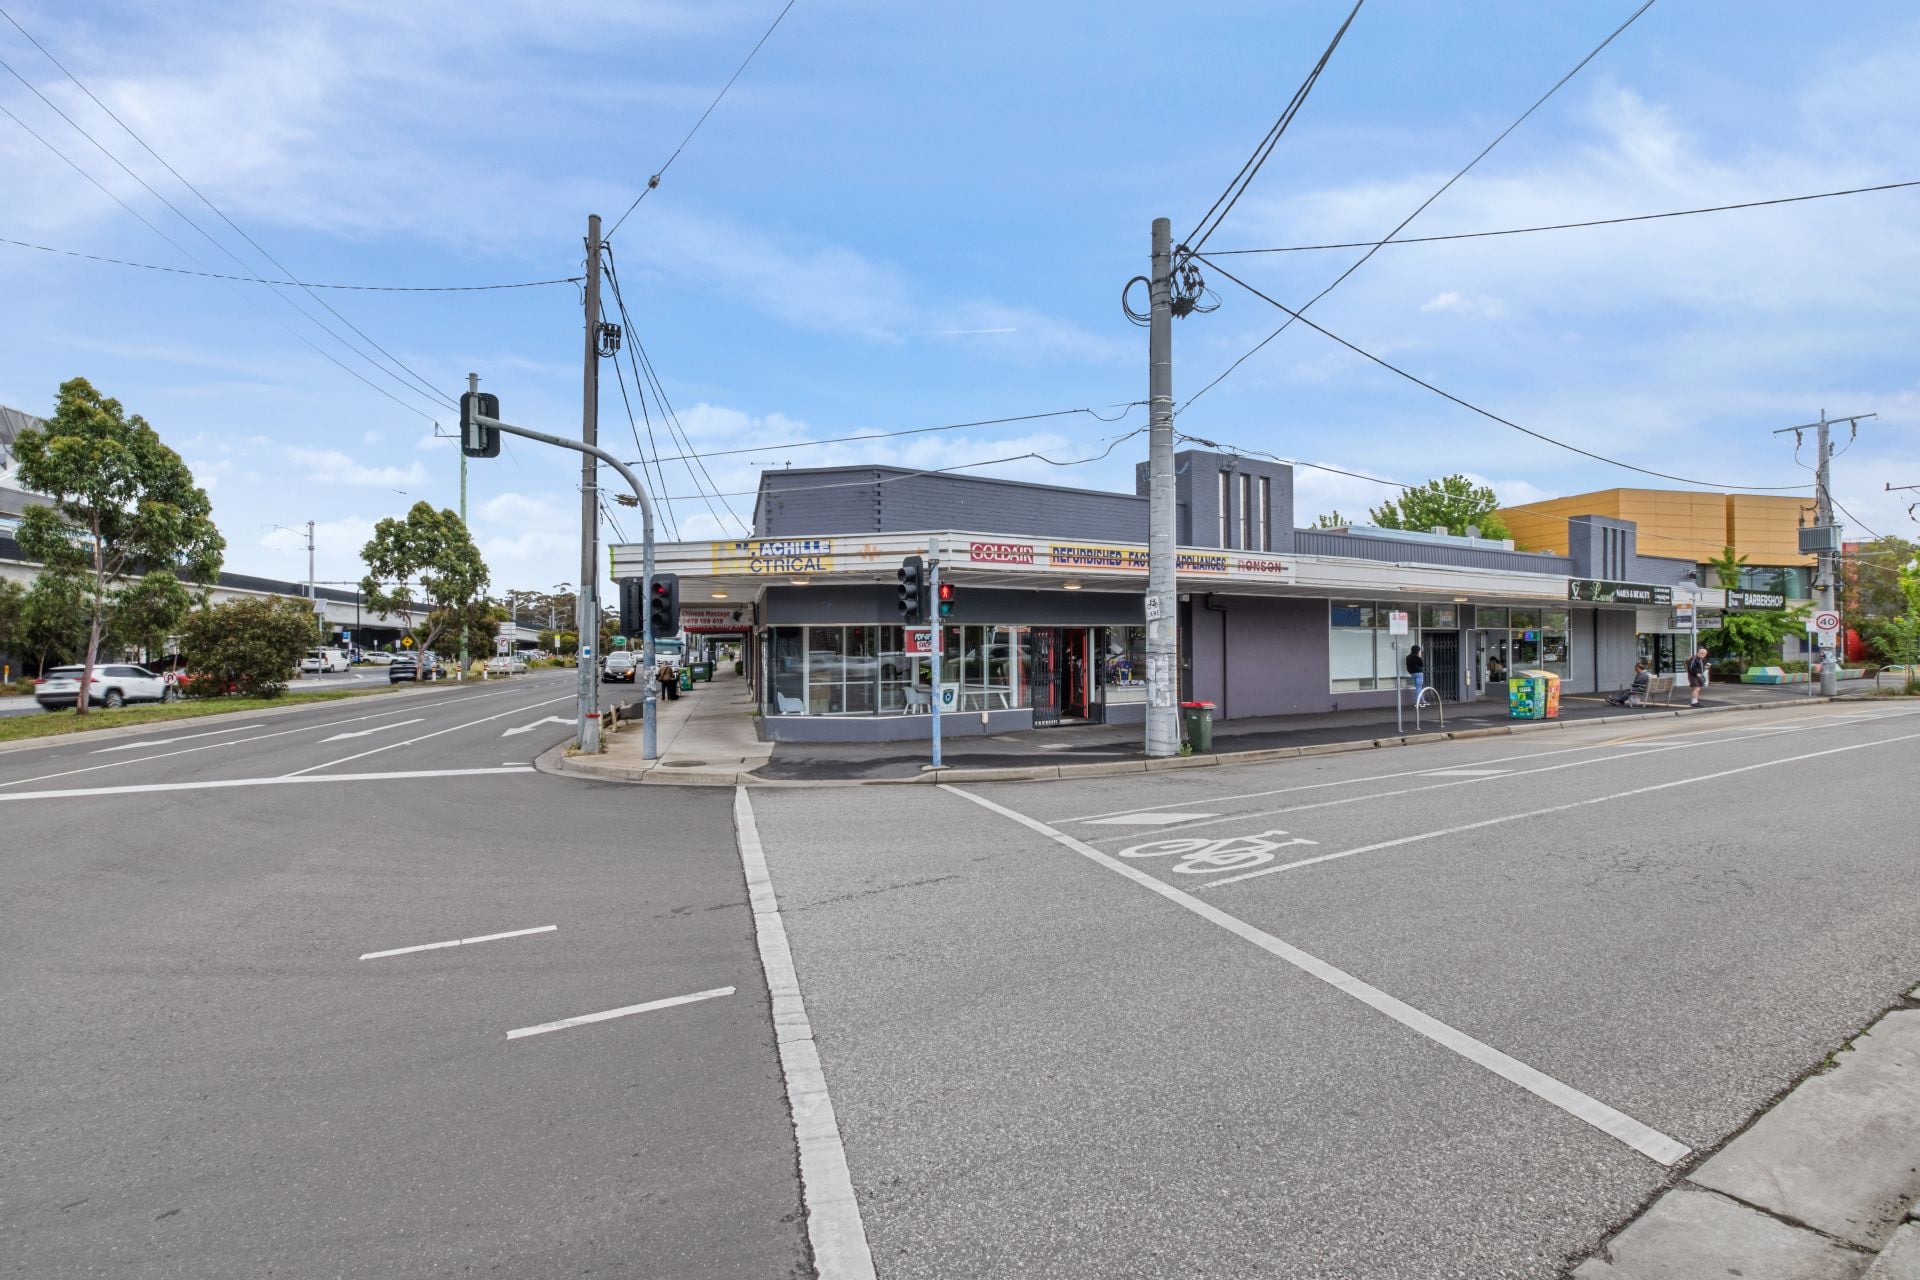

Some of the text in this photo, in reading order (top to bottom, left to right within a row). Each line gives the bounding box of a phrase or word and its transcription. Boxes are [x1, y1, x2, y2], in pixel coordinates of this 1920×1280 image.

[761, 541, 830, 556] ACHILLE
[971, 543, 1033, 563] GOLDAIR
[1052, 546, 1122, 566] REFURBISHED
[1176, 553, 1226, 572] APPLIANCES
[1237, 559, 1281, 573] RONSON
[1744, 593, 1784, 607] BARBERSHOP
[706, 610, 730, 618] Massage
[1147, 609, 1160, 617] LANE
[1820, 618, 1835, 626] 40
